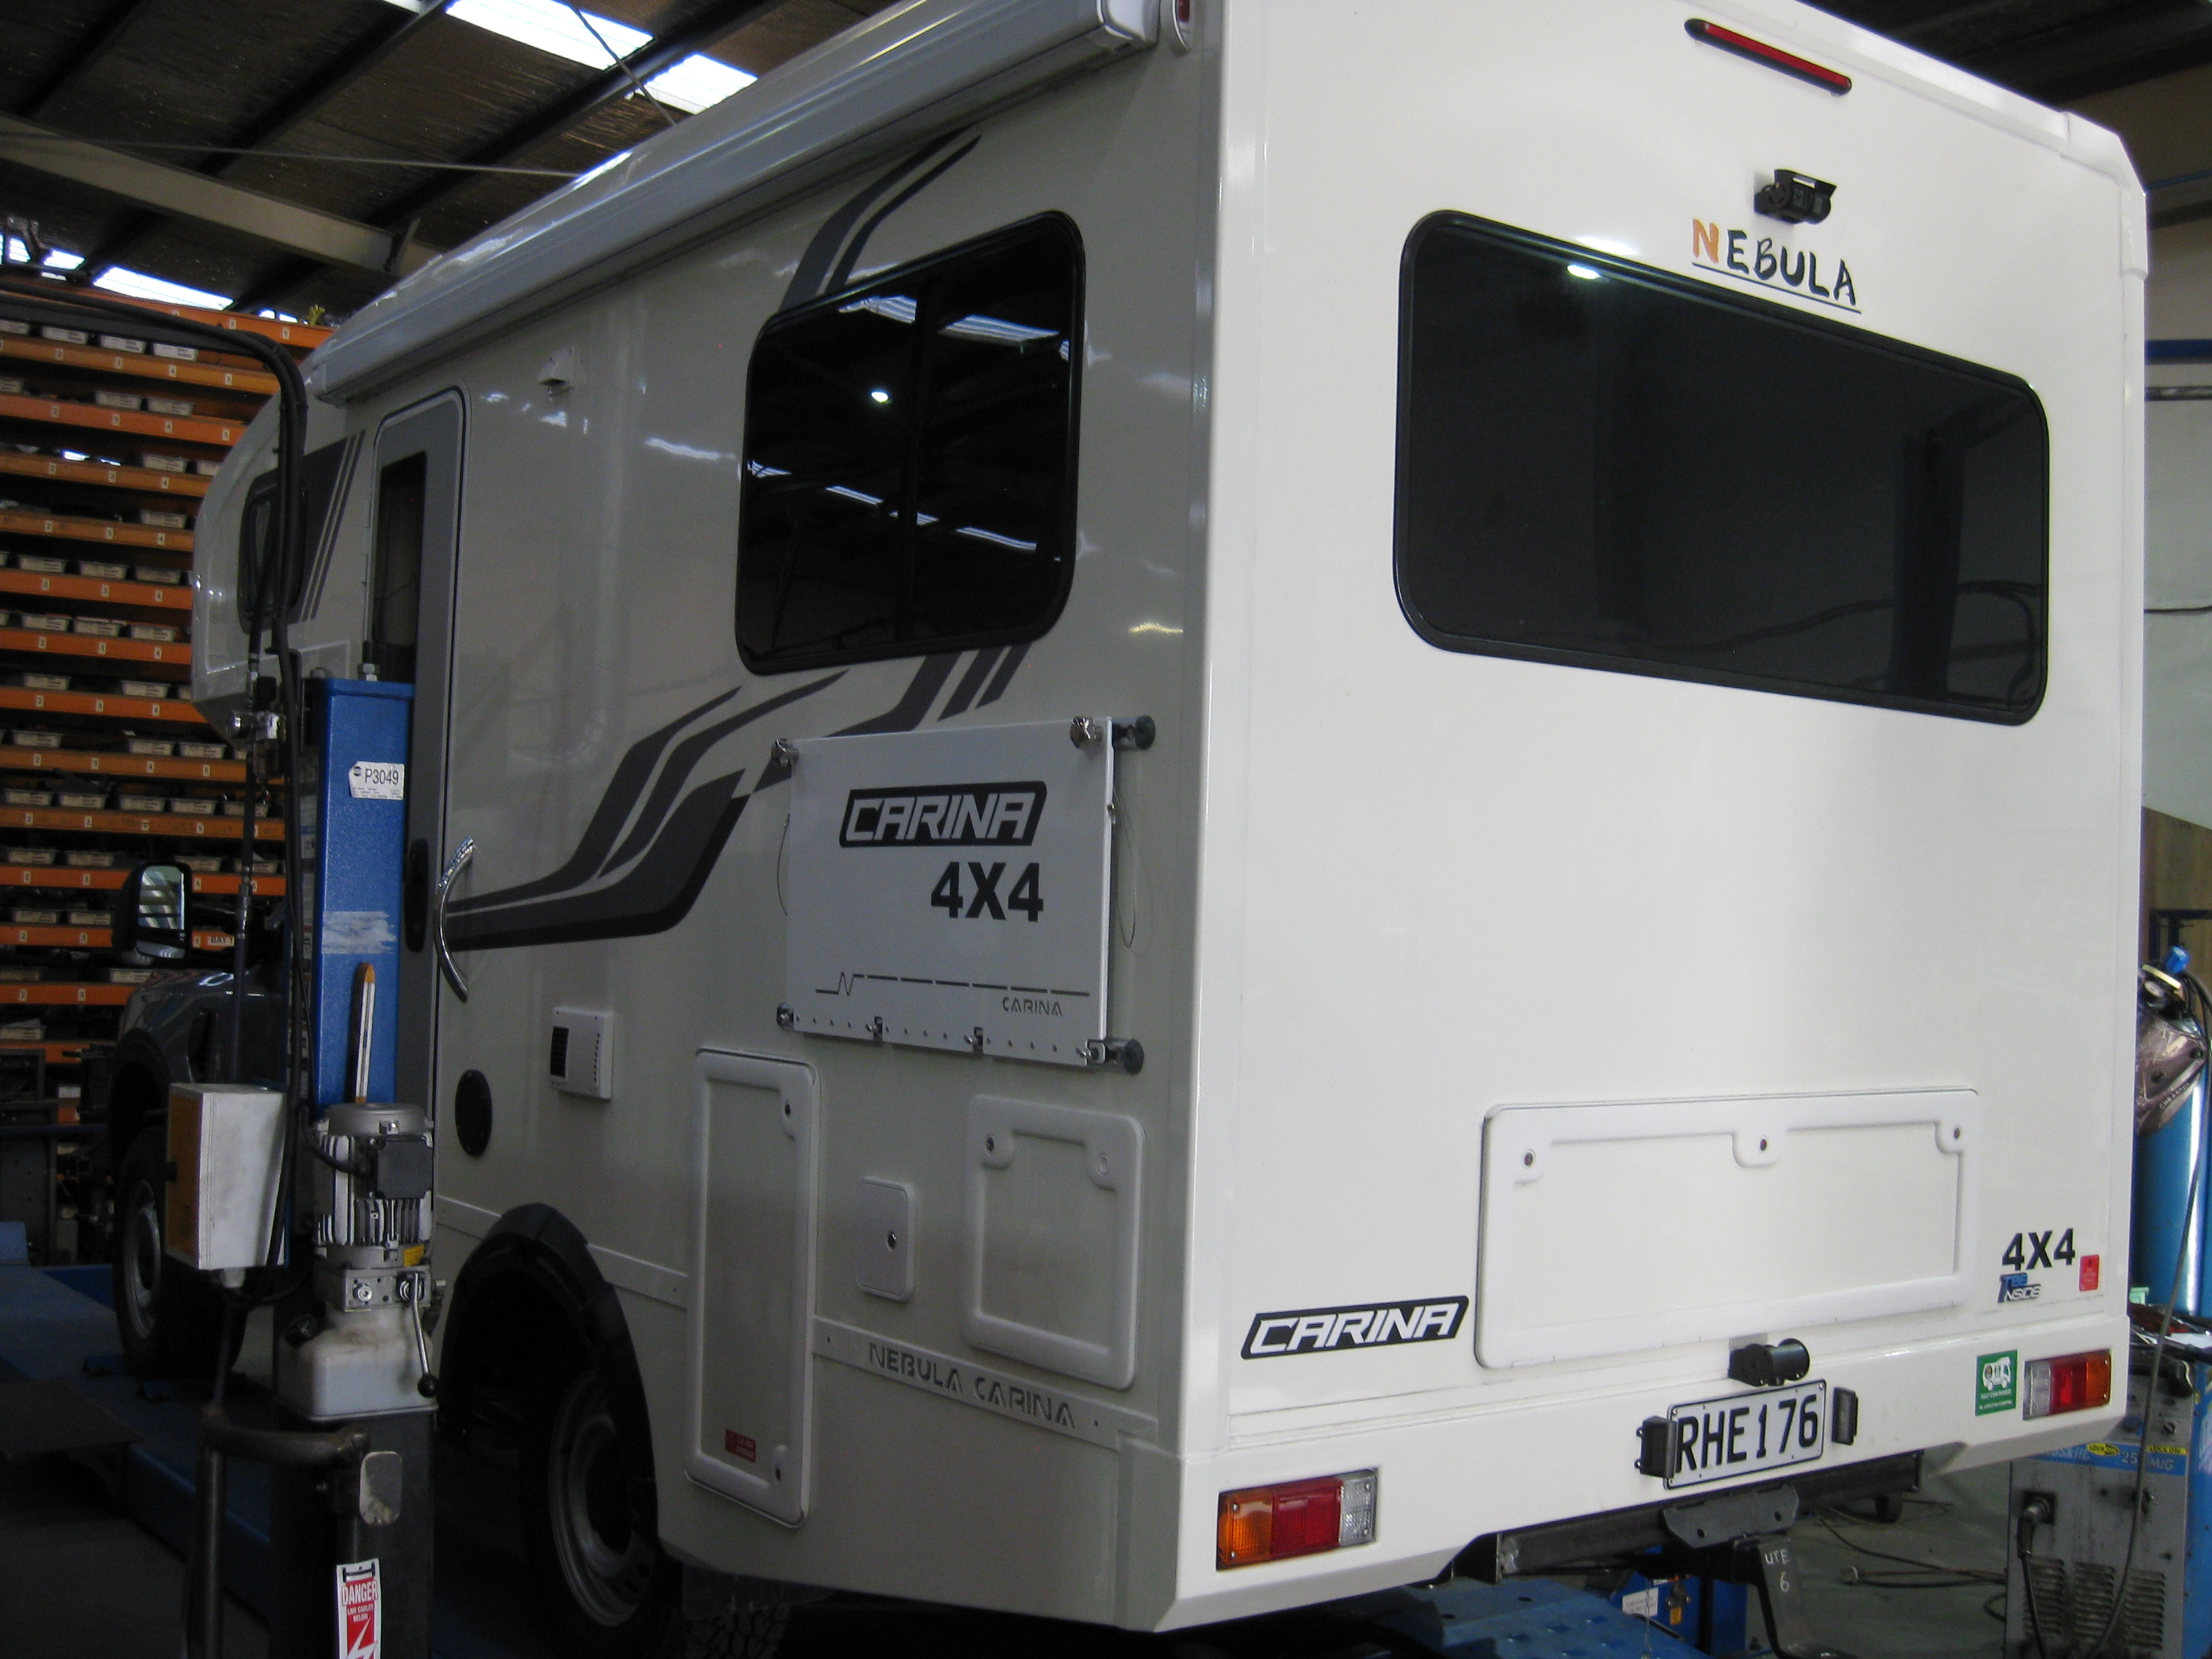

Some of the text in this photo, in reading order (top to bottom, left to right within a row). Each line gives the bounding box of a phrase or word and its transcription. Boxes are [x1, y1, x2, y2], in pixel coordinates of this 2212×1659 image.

[1692, 218, 1856, 306] NEBULA
[365, 769, 399, 785] P3049
[844, 790, 1038, 842] CARINA
[930, 861, 1044, 922] 4X4
[1002, 996, 1063, 1017] CARINA
[2002, 1228, 2076, 1271] 4X4
[1250, 1303, 1460, 1355] CARINA
[869, 1343, 1076, 1429] NEBULA CARINA
[1675, 1393, 1818, 1473] RHE176
[2149, 1457, 2174, 1471] MIG
[342, 1580, 379, 1606] DANGER
[1780, 1571, 1789, 1592] 6
